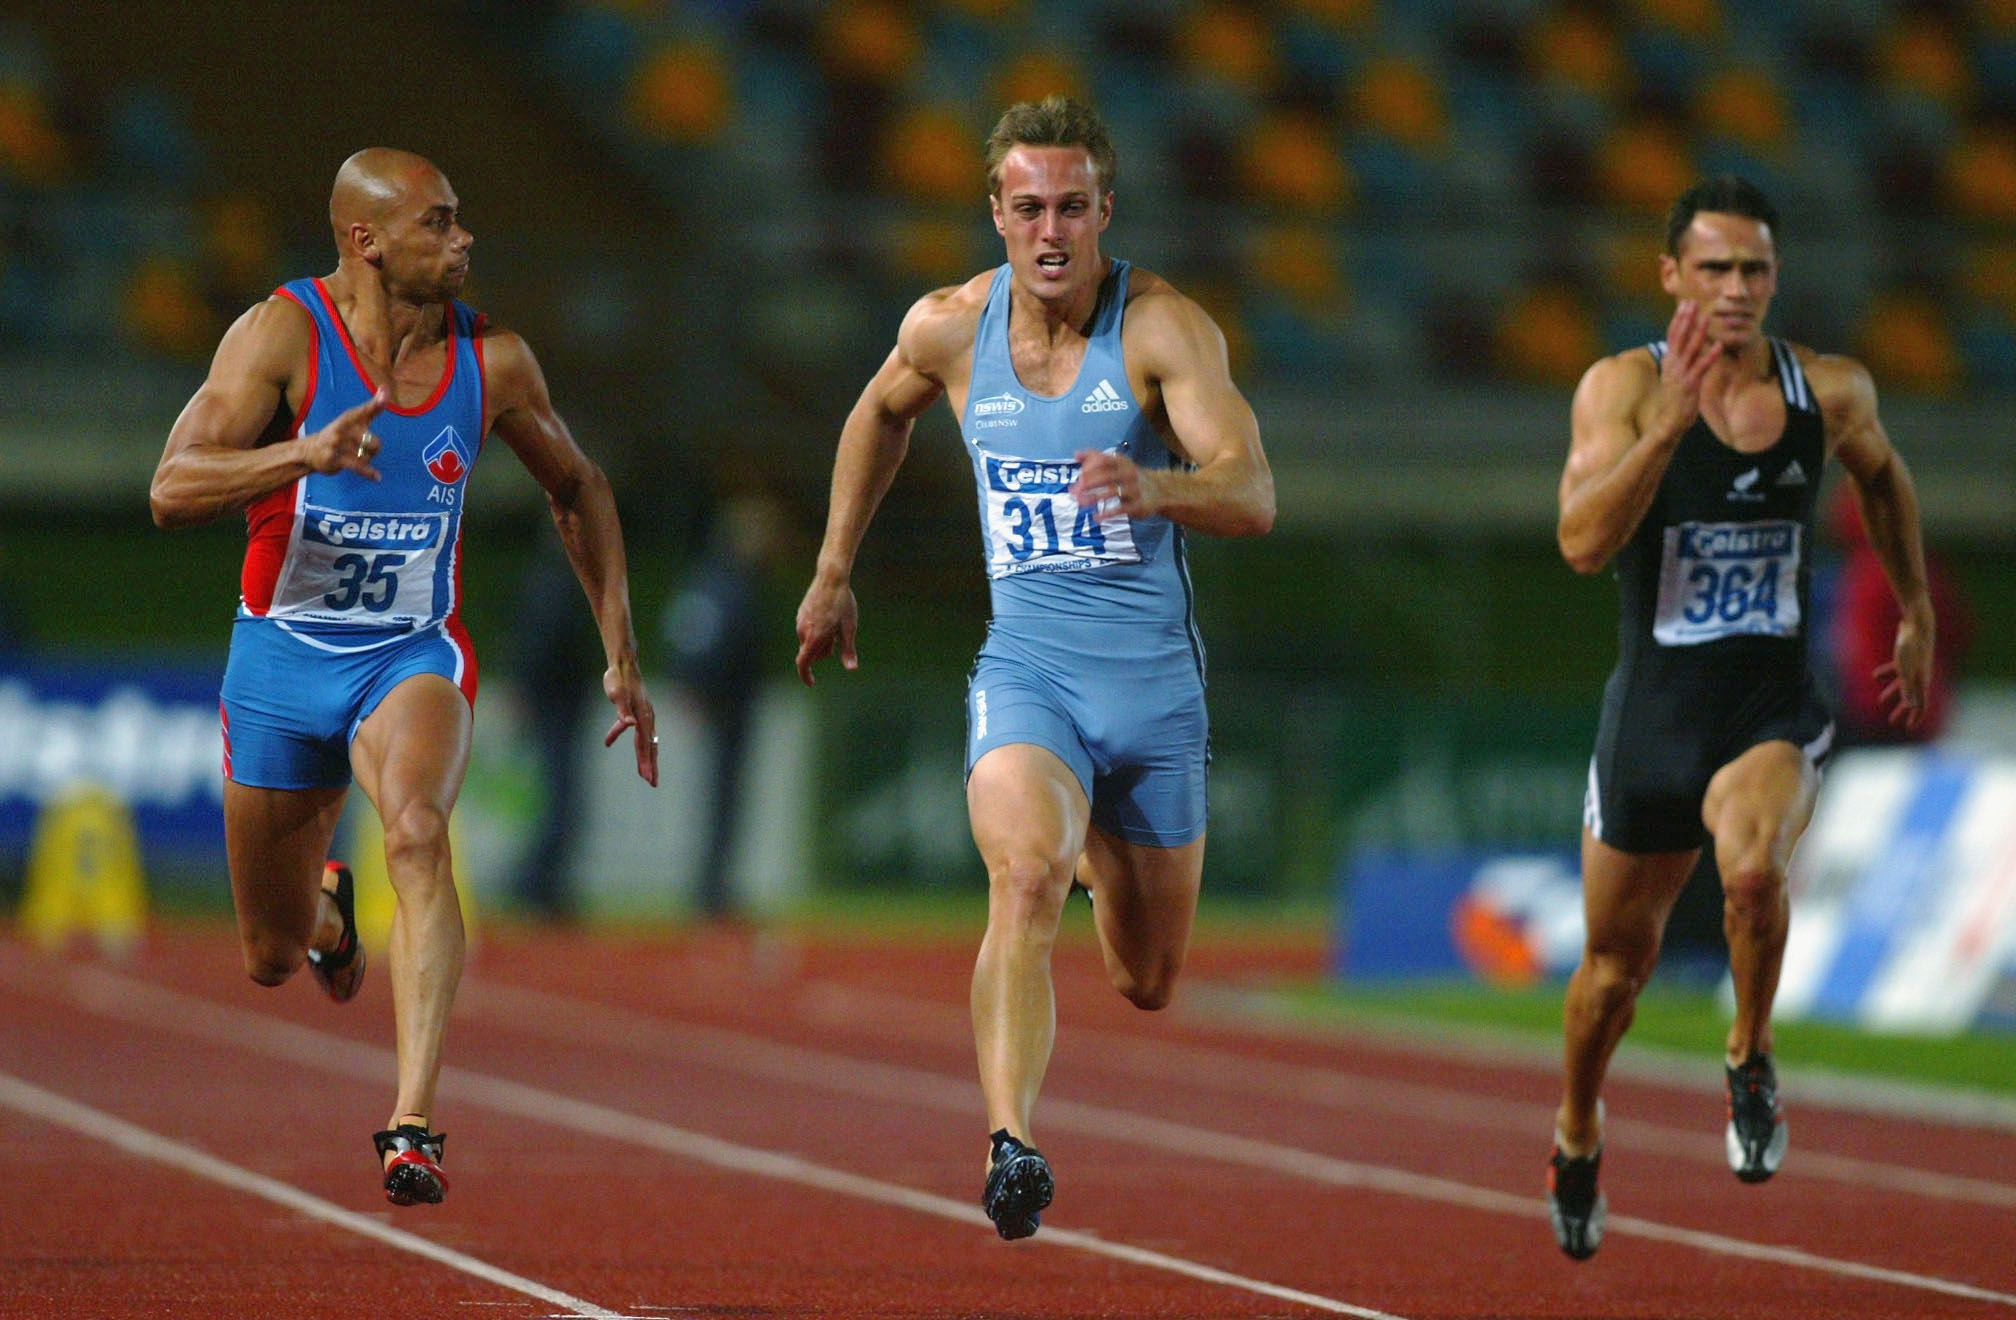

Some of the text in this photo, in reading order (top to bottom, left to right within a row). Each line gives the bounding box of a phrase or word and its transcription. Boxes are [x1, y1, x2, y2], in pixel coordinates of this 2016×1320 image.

[1081, 399, 1128, 413] adidas
[997, 462, 1082, 491] Telstr
[427, 484, 455, 505] AIS
[319, 514, 430, 544] Telstra
[1002, 497, 1106, 560] 314
[1015, 558, 1092, 573] CHAMPIONSHIPS
[324, 553, 406, 613] 35
[1683, 561, 1779, 624] 364
